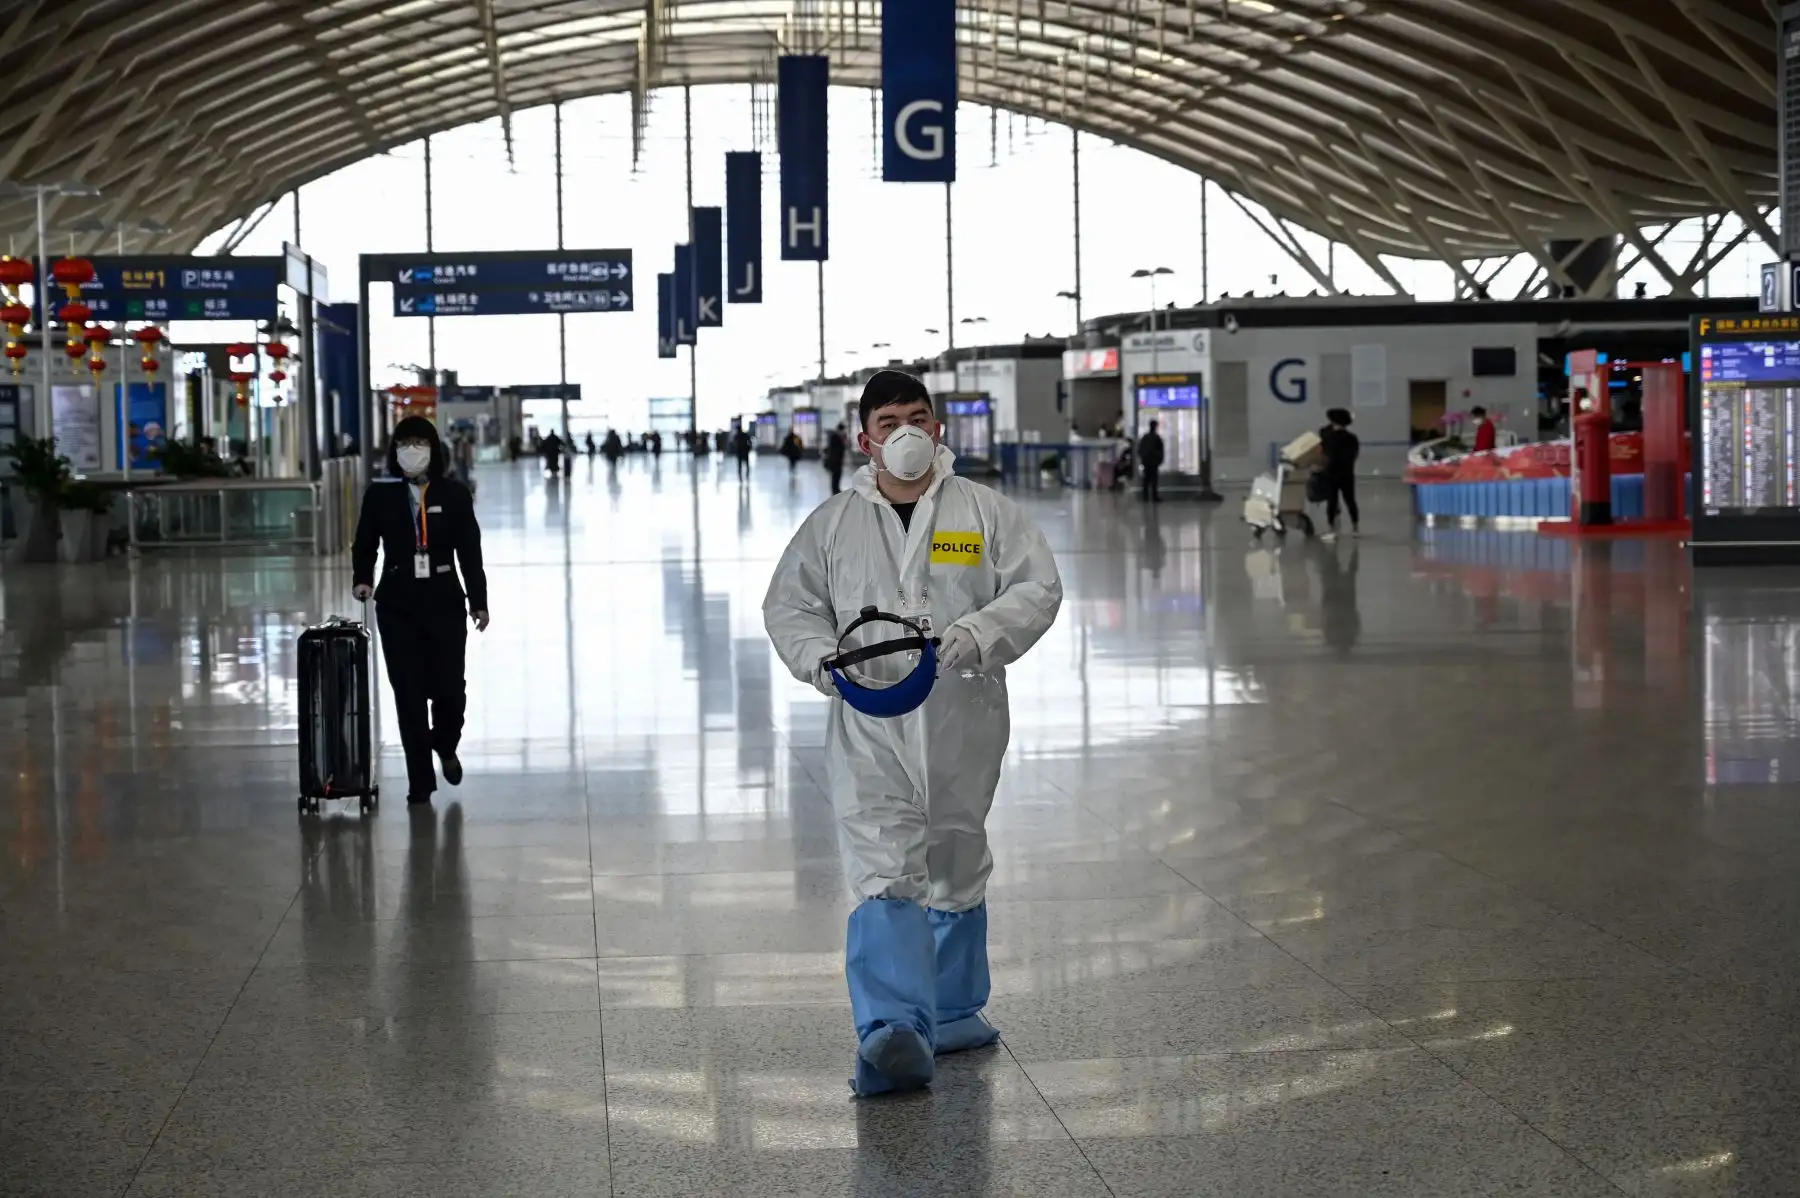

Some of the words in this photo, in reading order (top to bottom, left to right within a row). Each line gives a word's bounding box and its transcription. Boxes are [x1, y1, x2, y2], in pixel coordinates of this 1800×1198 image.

[894, 99, 945, 160] G
[788, 206, 822, 248] H
[156, 270, 164, 288] 1
[185, 271, 197, 287] P
[736, 262, 755, 295] J
[699, 296, 718, 321] K
[678, 317, 694, 340] L
[1699, 318, 1711, 336] F
[1192, 332, 1205, 353] G
[1268, 358, 1308, 403] G
[932, 542, 981, 554] POLICE
